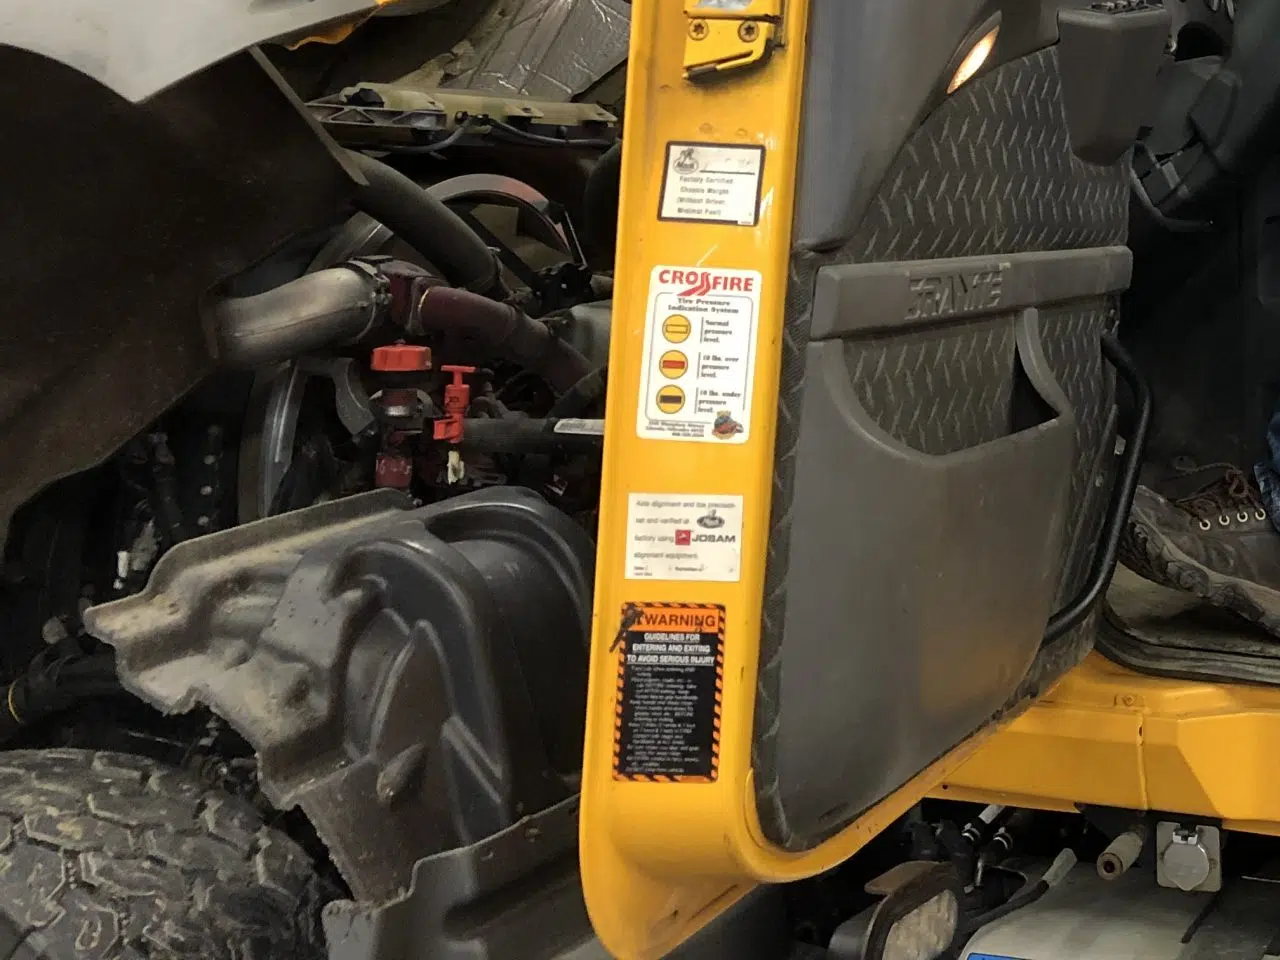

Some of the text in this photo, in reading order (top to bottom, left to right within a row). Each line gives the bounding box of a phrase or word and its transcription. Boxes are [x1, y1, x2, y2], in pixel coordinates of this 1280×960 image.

[680, 176, 703, 184] Factory
[696, 298, 730, 306] Pressure
[711, 306, 739, 314] System
[651, 500, 681, 508] alignment
[692, 534, 736, 542] JOSAM
[645, 614, 716, 627] WARNING
[644, 632, 700, 641] GUIDELINES FOR
[632, 643, 711, 653] ENTERING AND EXITING
[627, 654, 716, 664] TO AVOID SERIOUS INJURY
